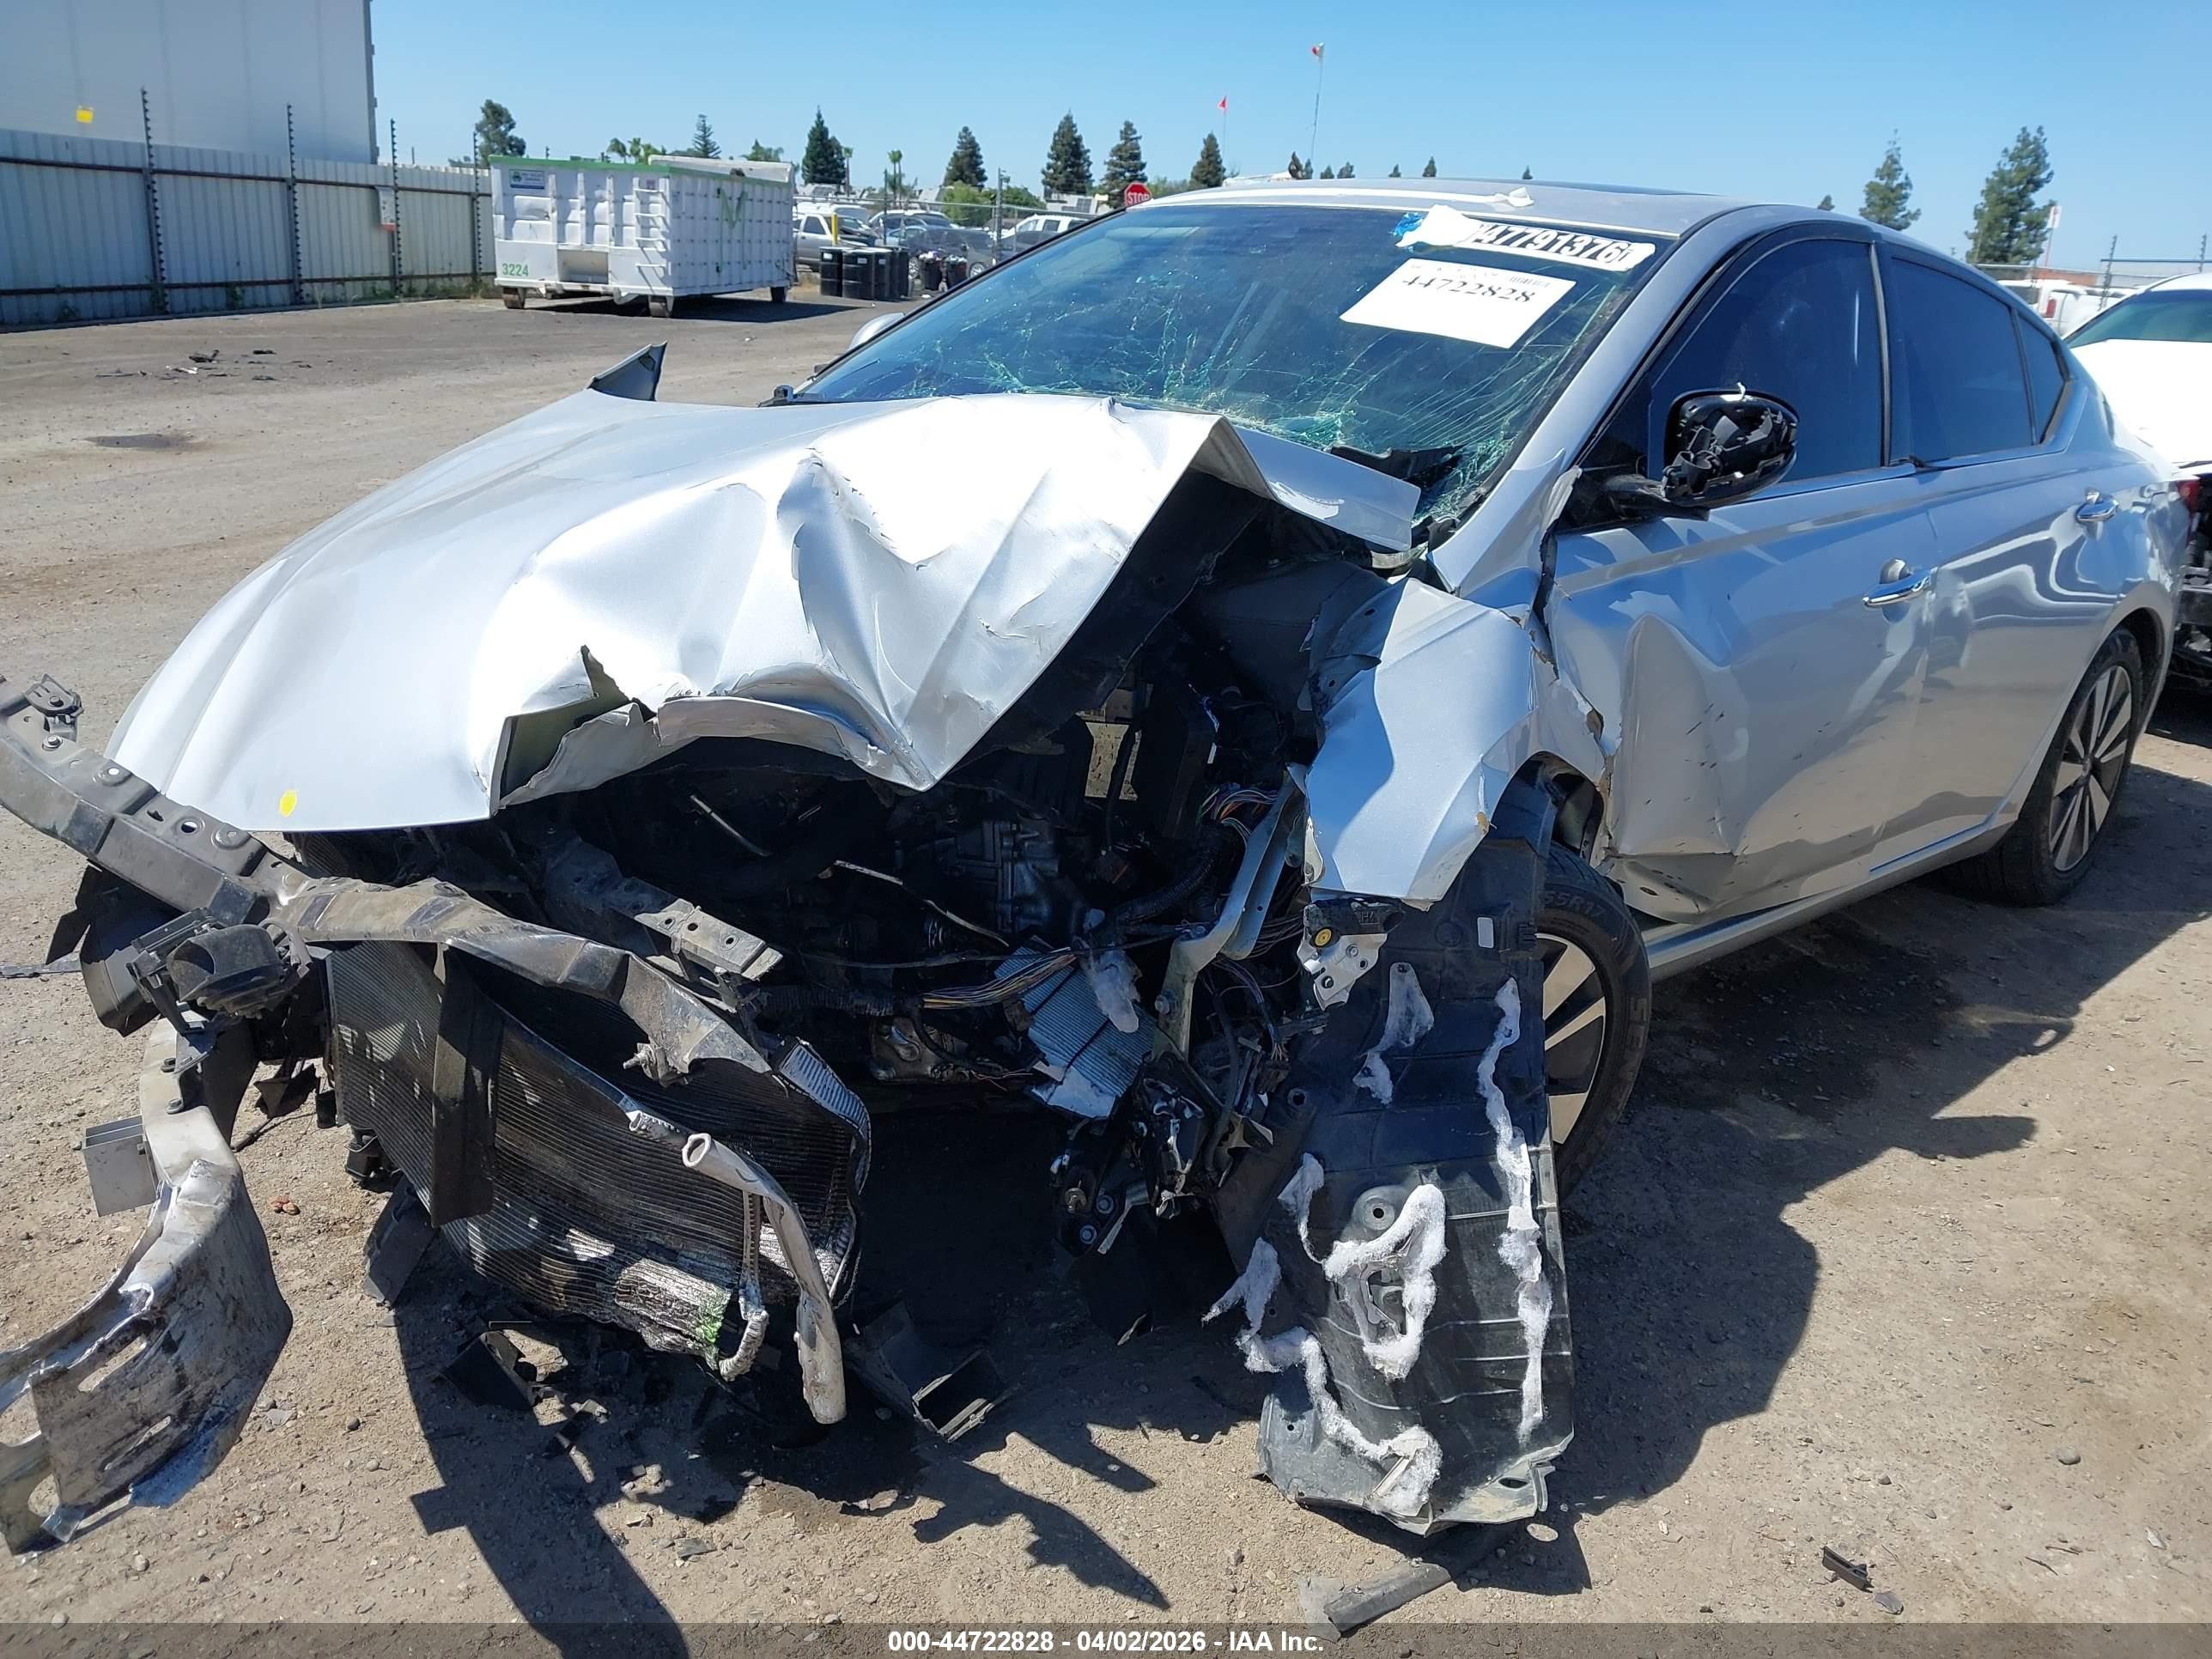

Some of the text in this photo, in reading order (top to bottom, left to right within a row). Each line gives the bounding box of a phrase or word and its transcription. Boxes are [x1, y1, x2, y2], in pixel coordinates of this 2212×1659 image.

[1127, 191, 1151, 204] STOP
[501, 262, 529, 276] 3224
[1402, 275, 1535, 302] 44722828
